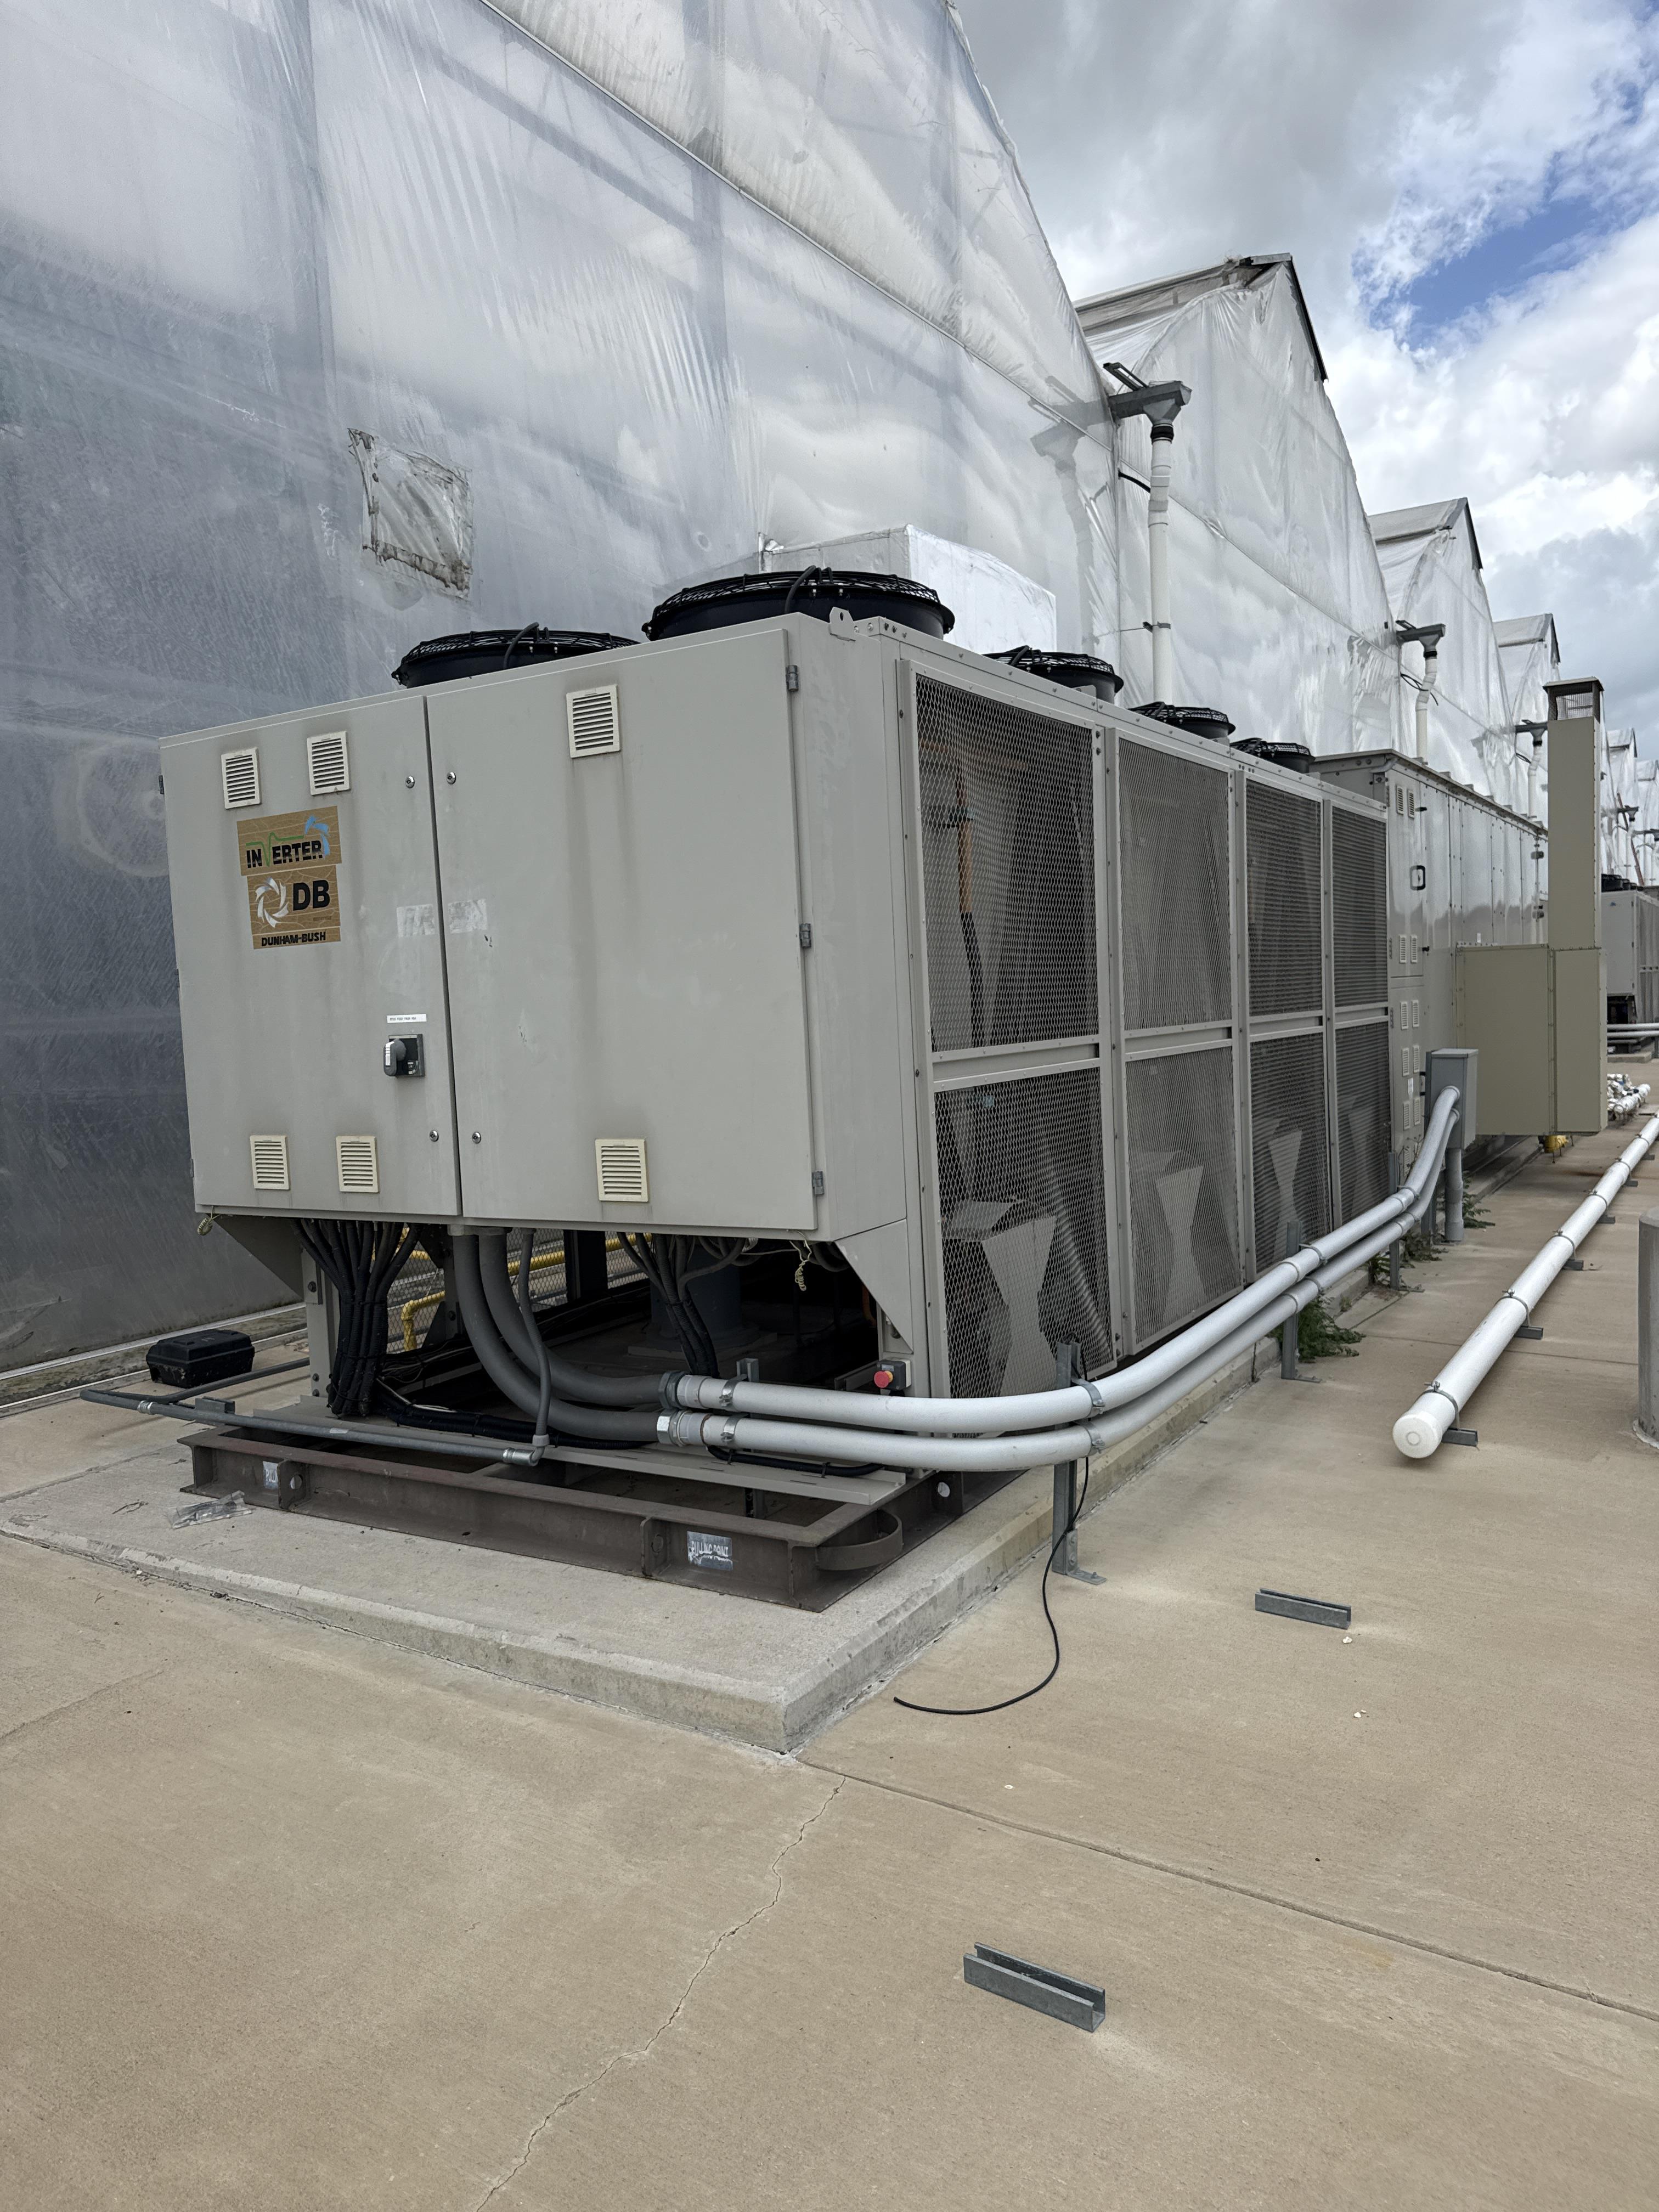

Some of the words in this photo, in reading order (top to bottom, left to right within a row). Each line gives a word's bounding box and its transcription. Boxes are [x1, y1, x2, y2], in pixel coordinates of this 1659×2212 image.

[246, 839, 323, 868] INVERTER
[293, 879, 330, 911] DB
[262, 932, 326, 946] DUNHAM-BUSH
